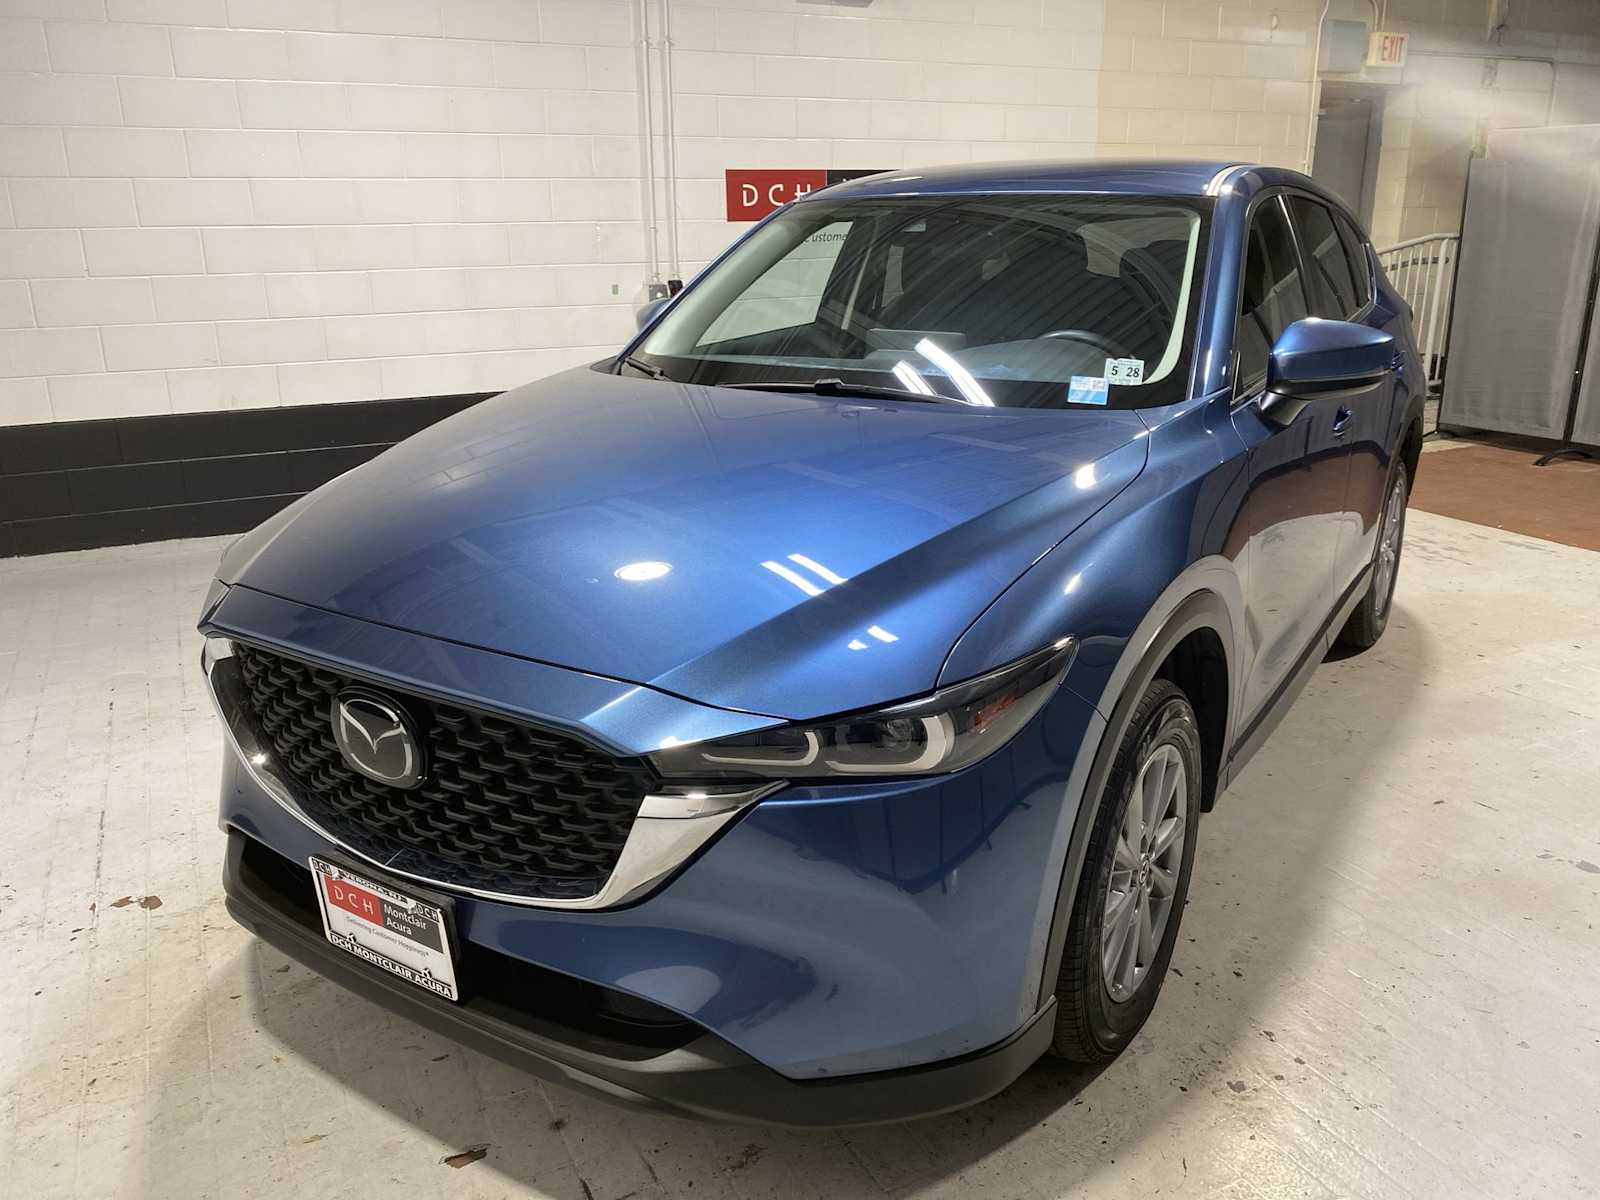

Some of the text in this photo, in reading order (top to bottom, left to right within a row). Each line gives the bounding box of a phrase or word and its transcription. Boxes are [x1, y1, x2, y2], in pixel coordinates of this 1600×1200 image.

[1381, 35, 1405, 63] EXIT
[1111, 366, 1140, 378] 5 28
[312, 859, 332, 874] DCH
[334, 885, 374, 915] DCH
[384, 903, 426, 929] Montclair
[416, 903, 439, 921] DCH
[386, 917, 412, 936] Acura
[332, 935, 451, 997] DCH MONTCLAIR ACURA
